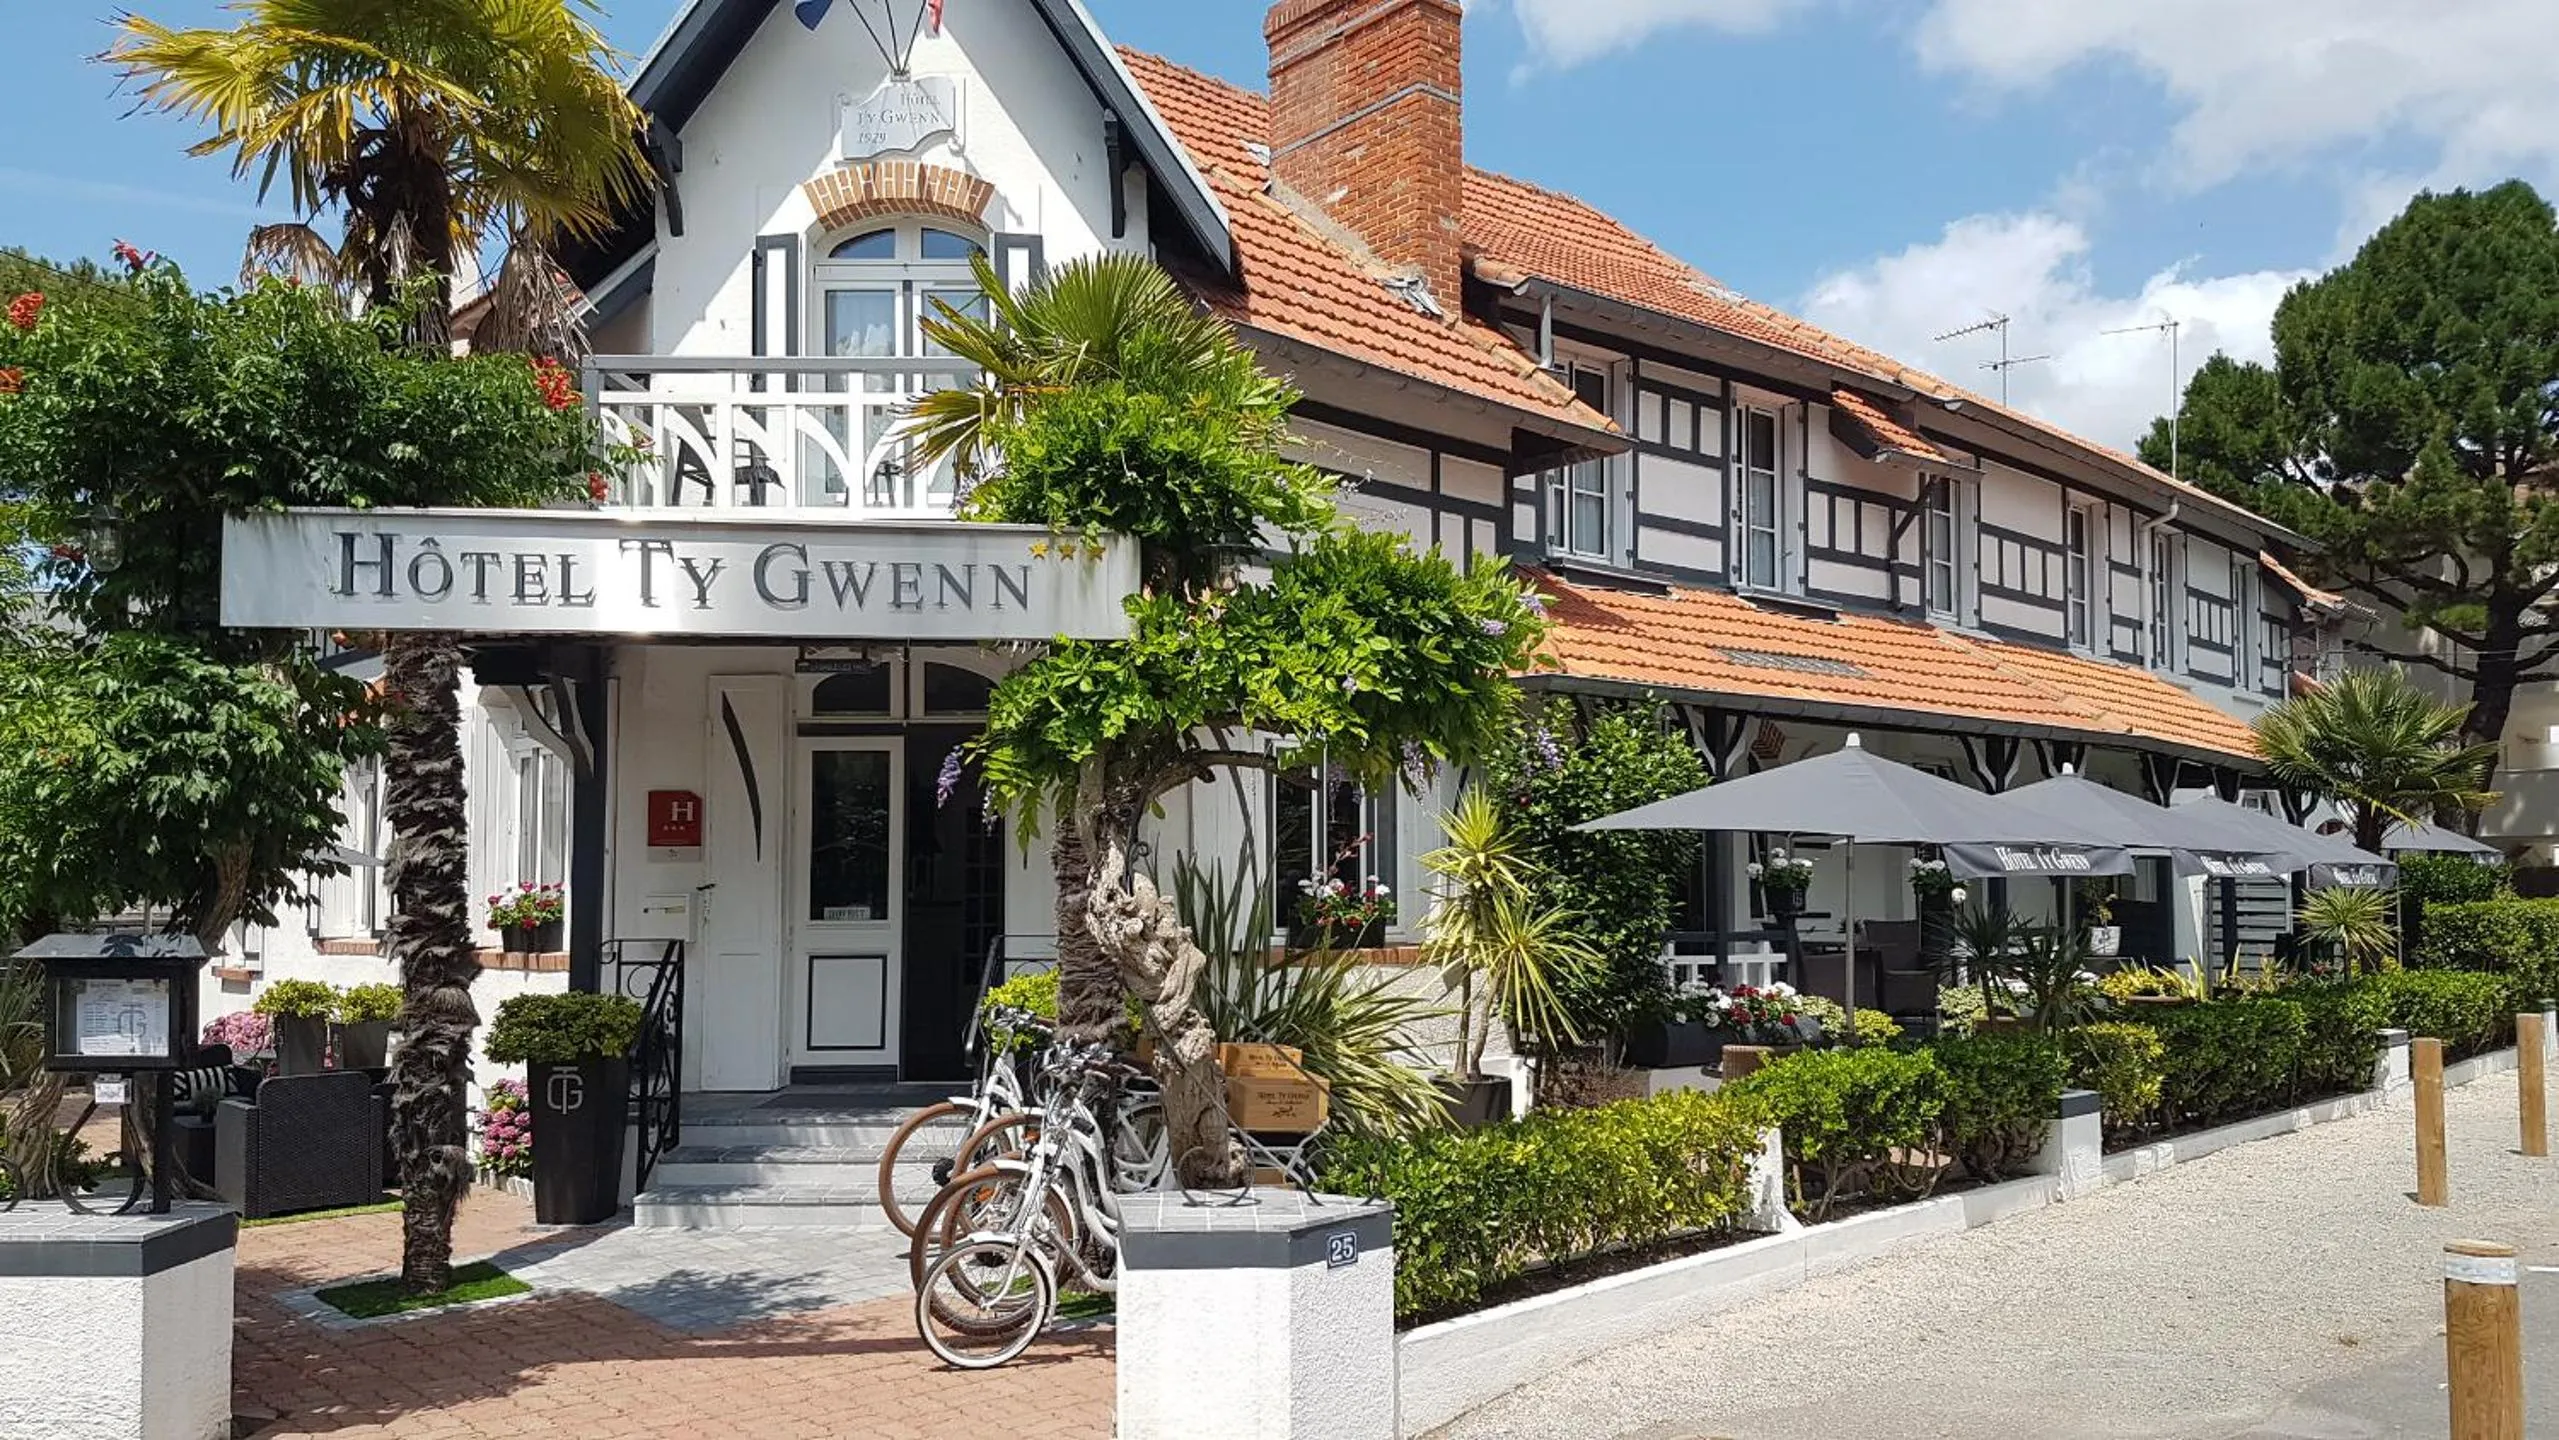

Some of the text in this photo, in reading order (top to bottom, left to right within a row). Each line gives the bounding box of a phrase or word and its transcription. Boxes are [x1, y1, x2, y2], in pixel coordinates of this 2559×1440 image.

[332, 532, 1032, 615] HÔTEL TY GWENN
[671, 801, 694, 821] H
[1331, 1236, 1354, 1261] 25
